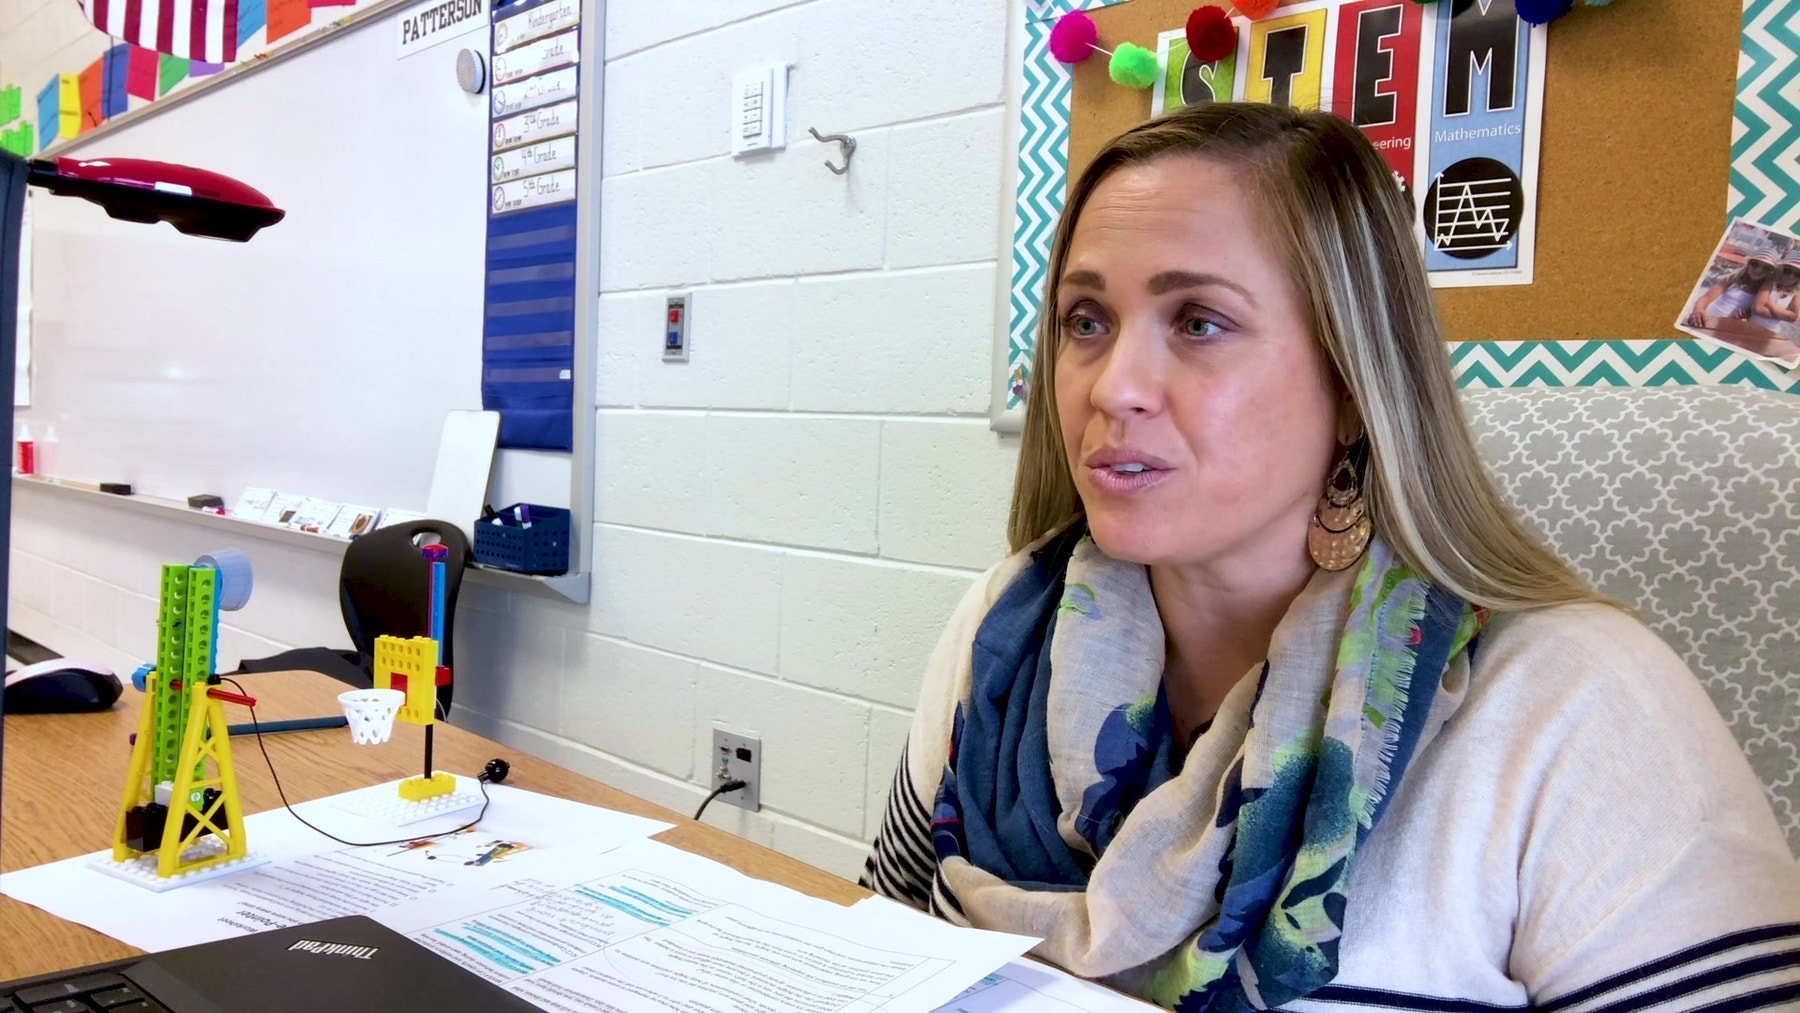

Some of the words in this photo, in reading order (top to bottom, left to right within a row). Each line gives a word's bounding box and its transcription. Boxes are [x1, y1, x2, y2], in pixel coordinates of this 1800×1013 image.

[402, 0, 482, 45] PATTERSON
[537, 108, 560, 129] Grade
[1373, 136, 1411, 150] eering
[1435, 122, 1521, 143] Mathematics
[534, 143, 557, 164] Grade
[537, 175, 560, 195] Grade
[236, 910, 287, 929] e-Pointer
[287, 939, 379, 960] ThinkPad
